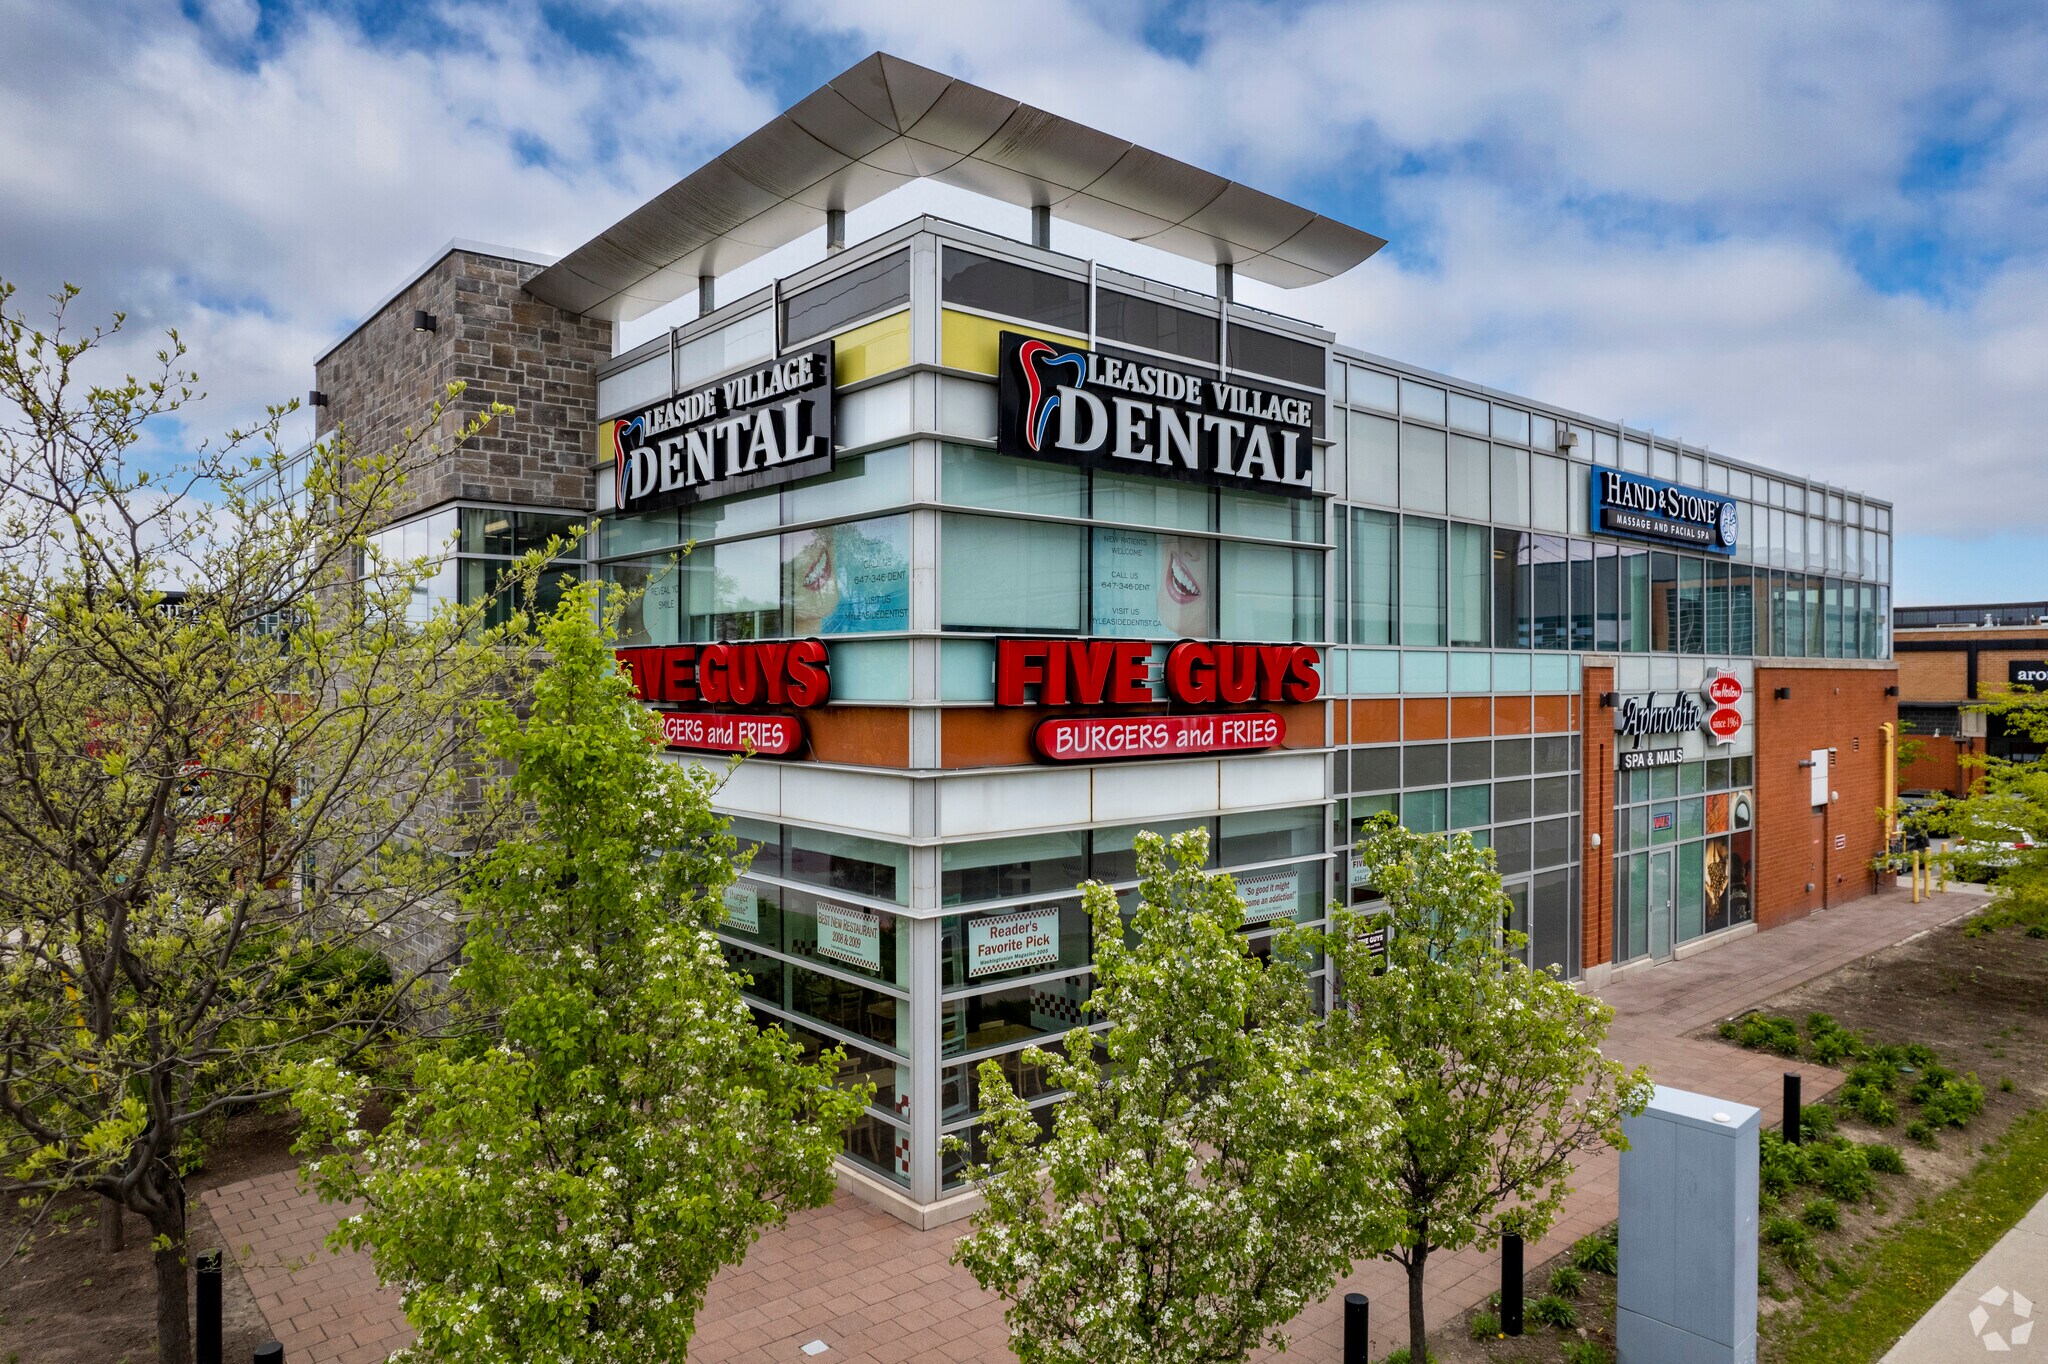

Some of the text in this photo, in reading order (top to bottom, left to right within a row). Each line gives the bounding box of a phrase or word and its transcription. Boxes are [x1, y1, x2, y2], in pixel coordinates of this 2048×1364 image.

[644, 352, 814, 437] LEASIDE VILLAGE
[1087, 353, 1311, 428] LEASIDE VILLAGE
[1055, 385, 1312, 487] DENTAL
[630, 398, 815, 500] DENTAL
[1607, 471, 1657, 512] HAND
[1616, 514, 1710, 540] MASSAGE AND FACIAL SPA
[1103, 536, 1148, 547] NEW PATIENTS
[1111, 547, 1143, 557] WELCOME
[854, 570, 906, 584] 647-346-DENT
[1111, 571, 1139, 580] CALL US
[1101, 581, 1150, 591] 647-346-DENT
[658, 599, 675, 610] SMILE
[1111, 607, 1140, 616] VISIT US
[700, 641, 831, 708] GUYS
[998, 640, 1321, 707] FIVE GUYS
[2017, 670, 2048, 681] aro
[1712, 683, 1721, 697] Tim
[1623, 691, 1701, 750] Aphrodite
[1712, 715, 1740, 728] since 1964
[707, 721, 733, 745] and
[738, 721, 784, 748] FRIES
[1056, 719, 1278, 753] BURGERS and FRIES
[1625, 749, 1683, 768] SPA & NAILS
[1255, 884, 1270, 896] good
[1260, 897, 1268, 905] an
[818, 911, 878, 939] BEST NEW RESTAURANT
[990, 920, 1039, 940] Reader's
[832, 930, 843, 944] 2008
[977, 934, 1050, 957] Favorite Pick
